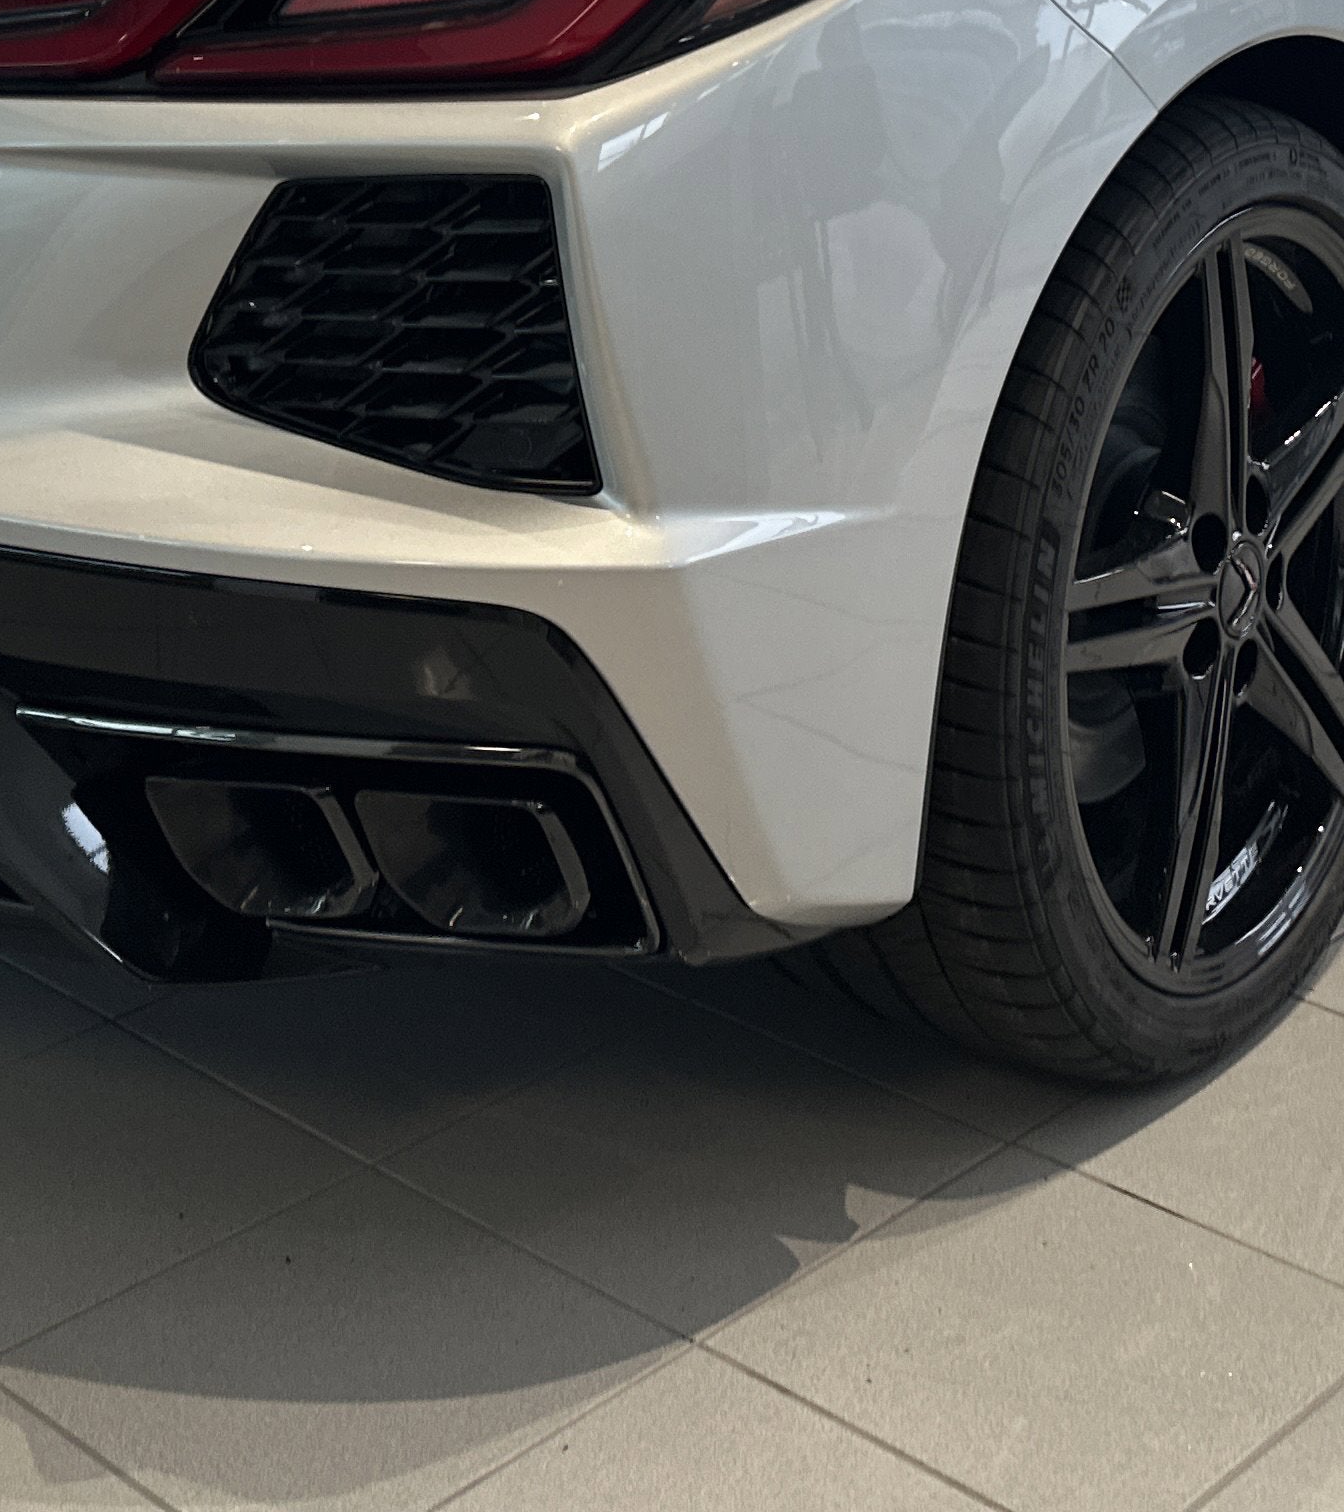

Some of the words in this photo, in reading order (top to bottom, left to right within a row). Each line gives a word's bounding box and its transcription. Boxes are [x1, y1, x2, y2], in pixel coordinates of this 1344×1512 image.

[1050, 394, 1086, 498] 305/30
[1081, 355, 1100, 392] ZR
[1098, 317, 1116, 353] 20
[1026, 535, 1056, 817] MICHELIN
[1205, 840, 1258, 912] RVETTE
